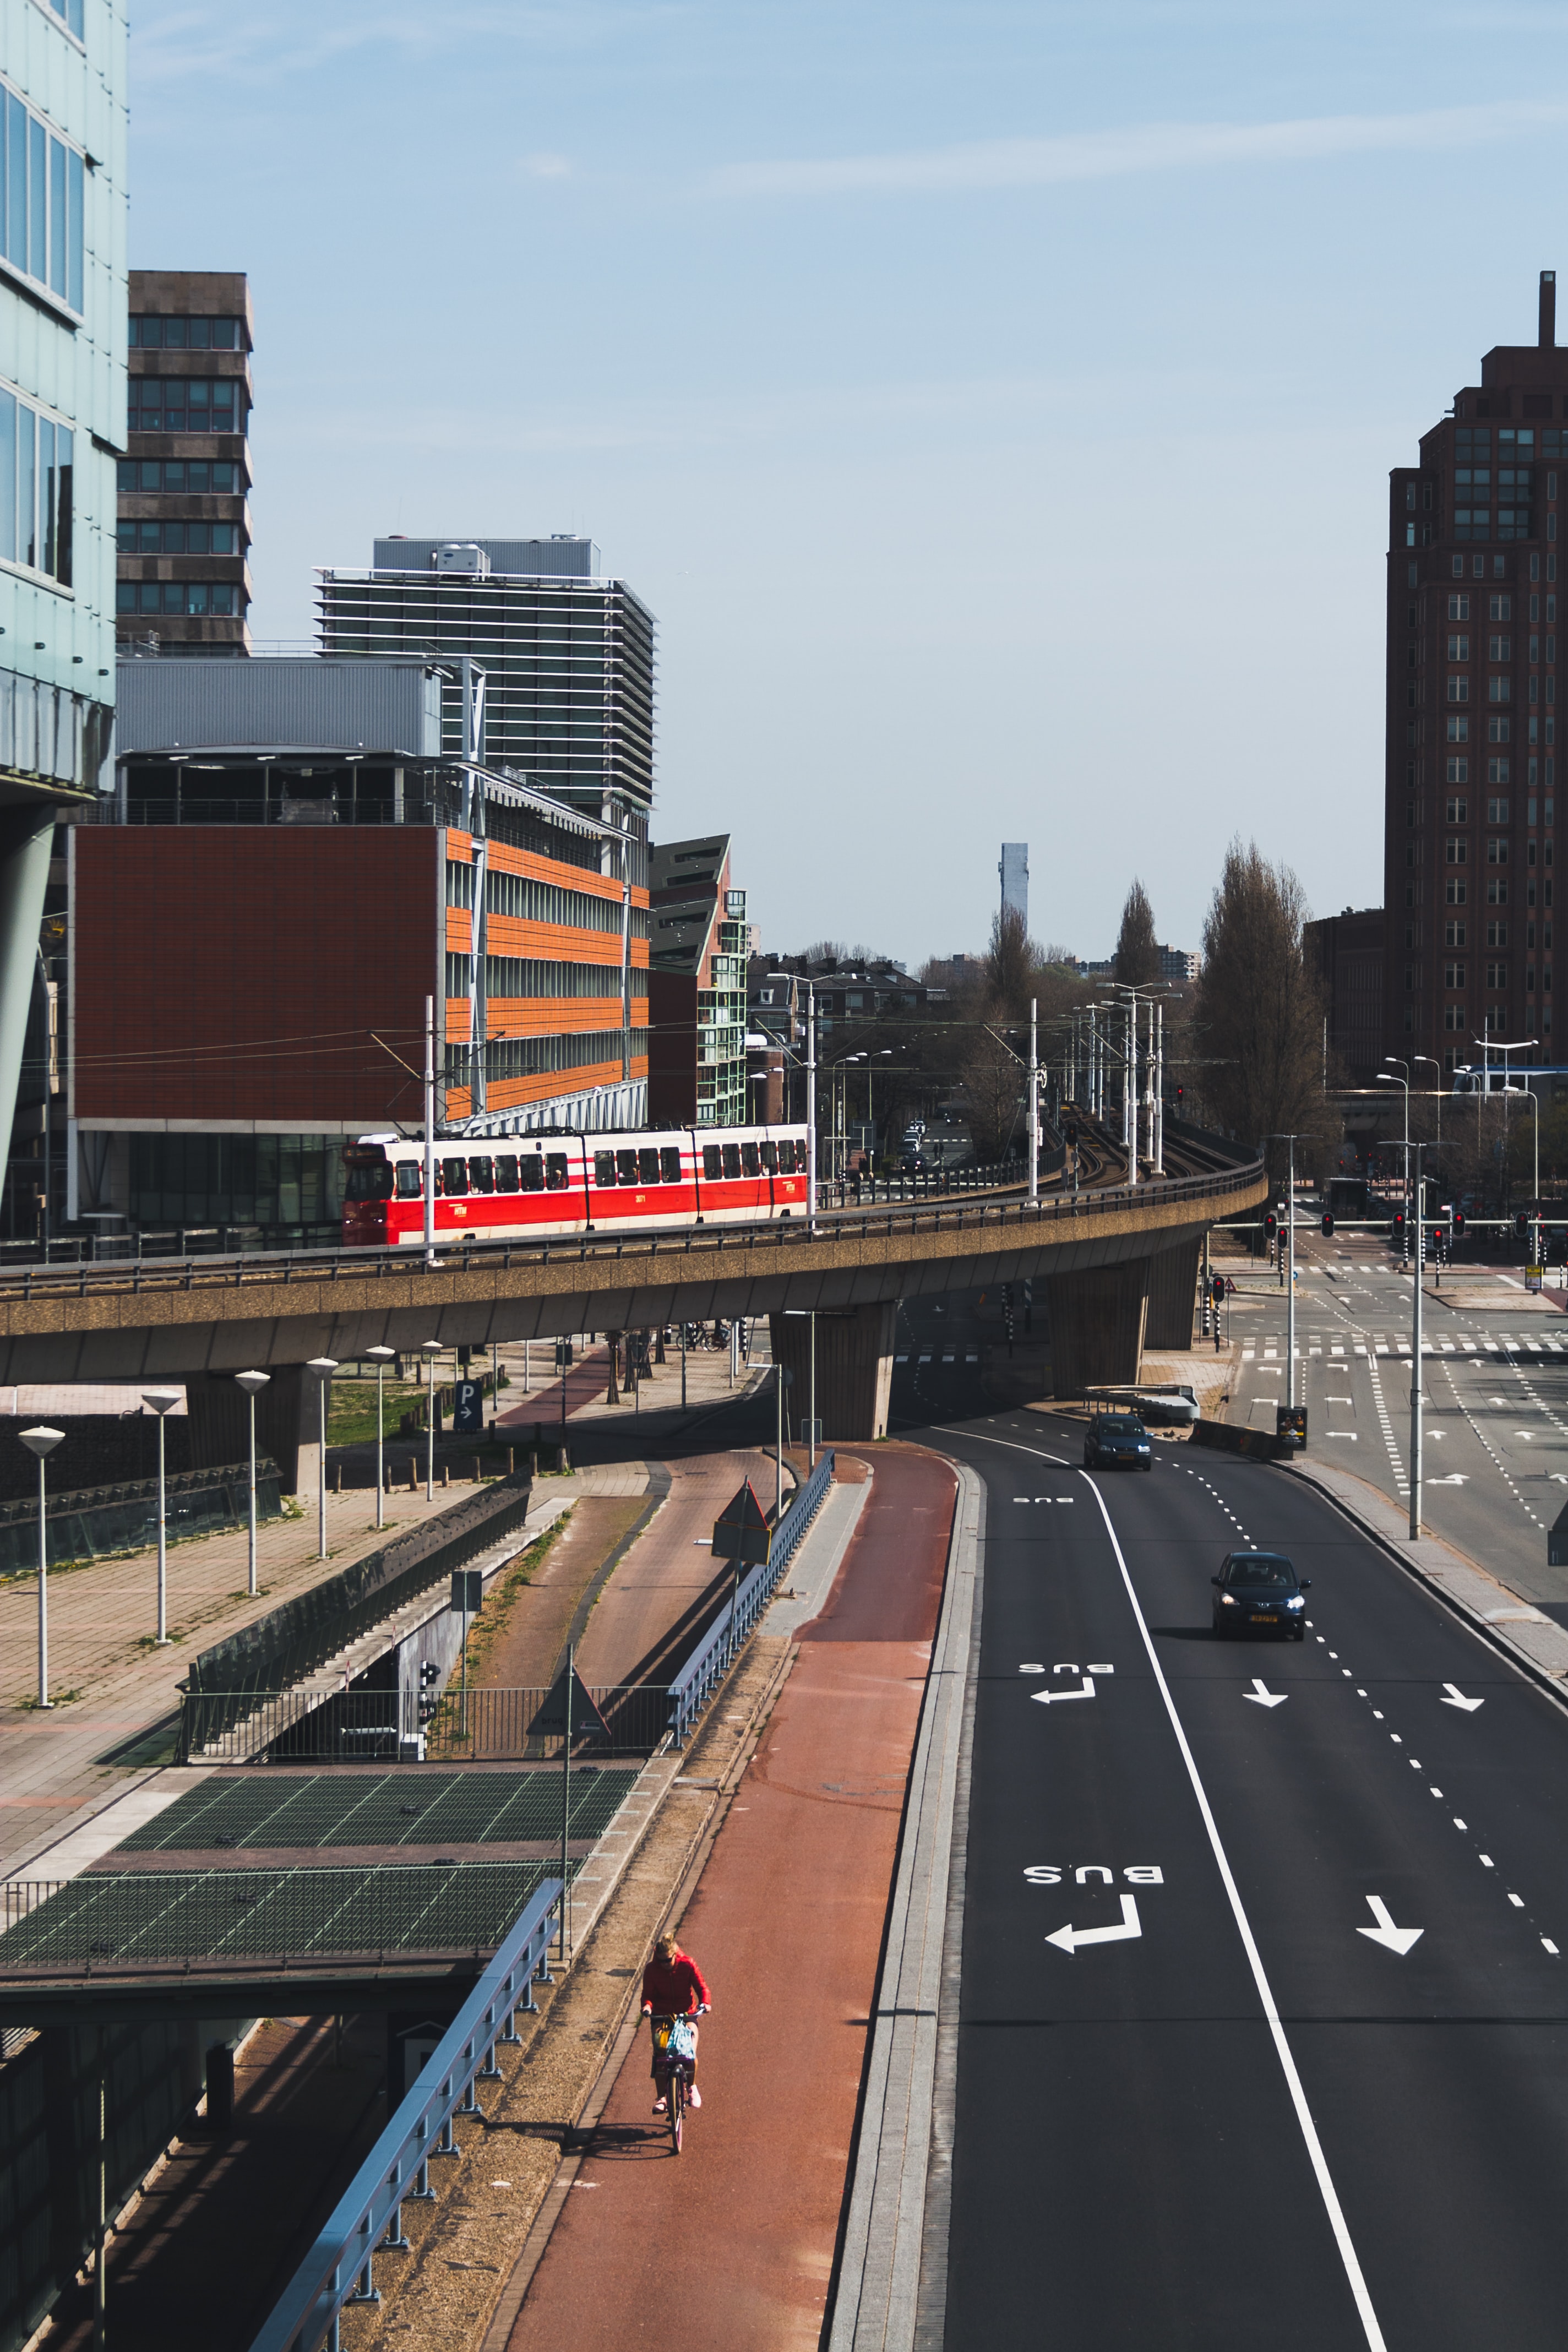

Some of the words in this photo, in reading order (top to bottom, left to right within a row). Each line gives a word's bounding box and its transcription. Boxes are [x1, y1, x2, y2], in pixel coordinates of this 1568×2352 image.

[454, 1206, 467, 1215] HTM
[461, 1385, 474, 1404] P
[1019, 1663, 1114, 1674] BUS
[542, 1717, 563, 1726] brug
[1023, 1865, 1164, 1884] BUS
